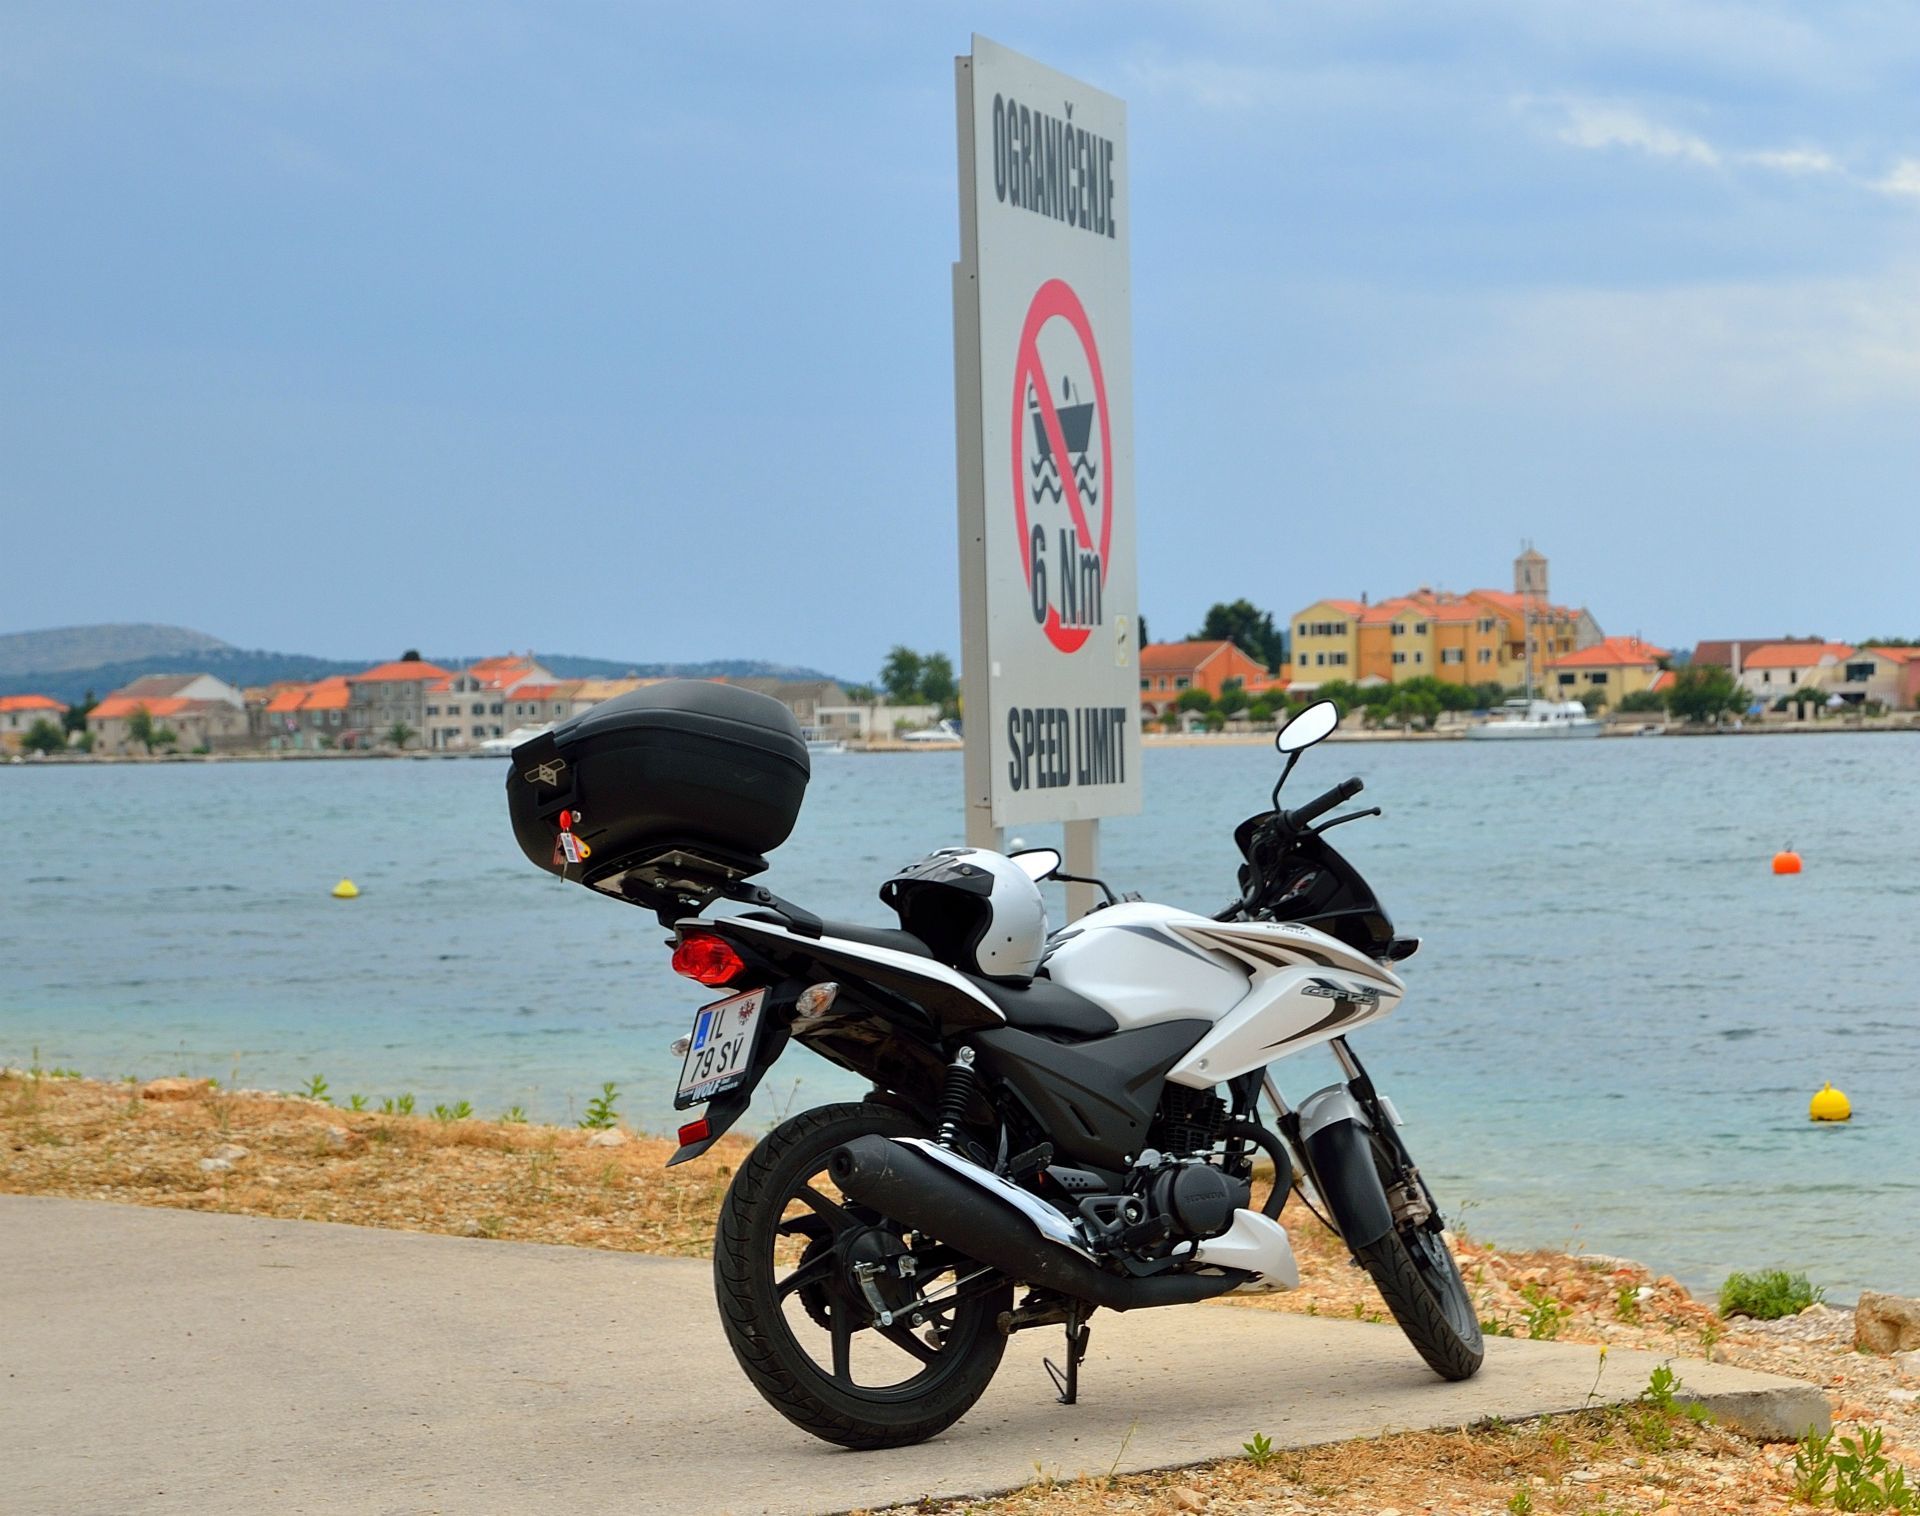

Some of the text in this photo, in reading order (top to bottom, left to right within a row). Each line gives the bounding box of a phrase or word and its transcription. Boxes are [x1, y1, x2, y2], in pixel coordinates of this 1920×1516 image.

[992, 92, 1116, 239] OGRANIČENJE
[1030, 523, 1103, 626] 6 Nm
[1008, 706, 1127, 793] SPEED LIMIT
[690, 1037, 744, 1083] 79 SV
[709, 1008, 725, 1042] IL
